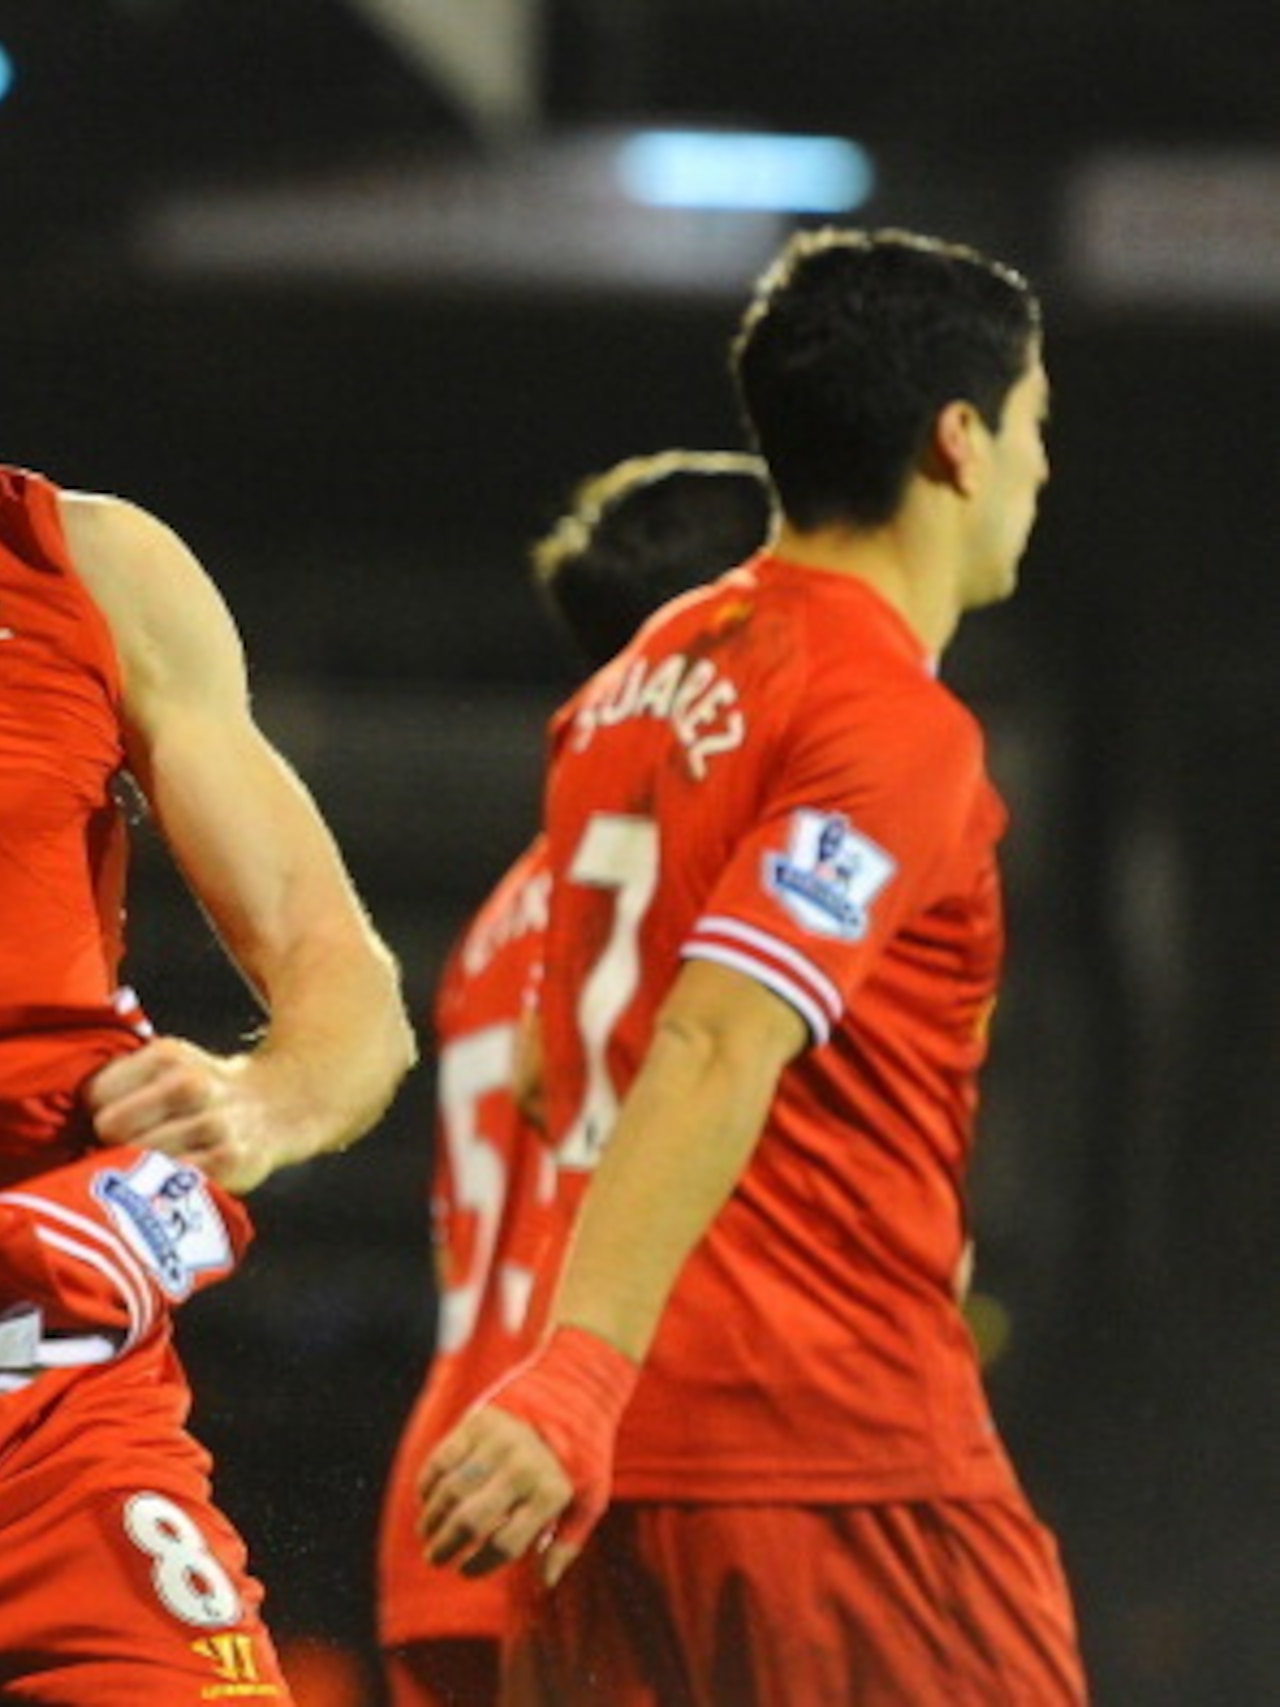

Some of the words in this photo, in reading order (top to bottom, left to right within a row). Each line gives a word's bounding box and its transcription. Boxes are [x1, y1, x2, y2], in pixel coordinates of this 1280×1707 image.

[554, 811, 661, 1170] 7
[435, 1016, 559, 1352] 5
[123, 1489, 244, 1630] 8
